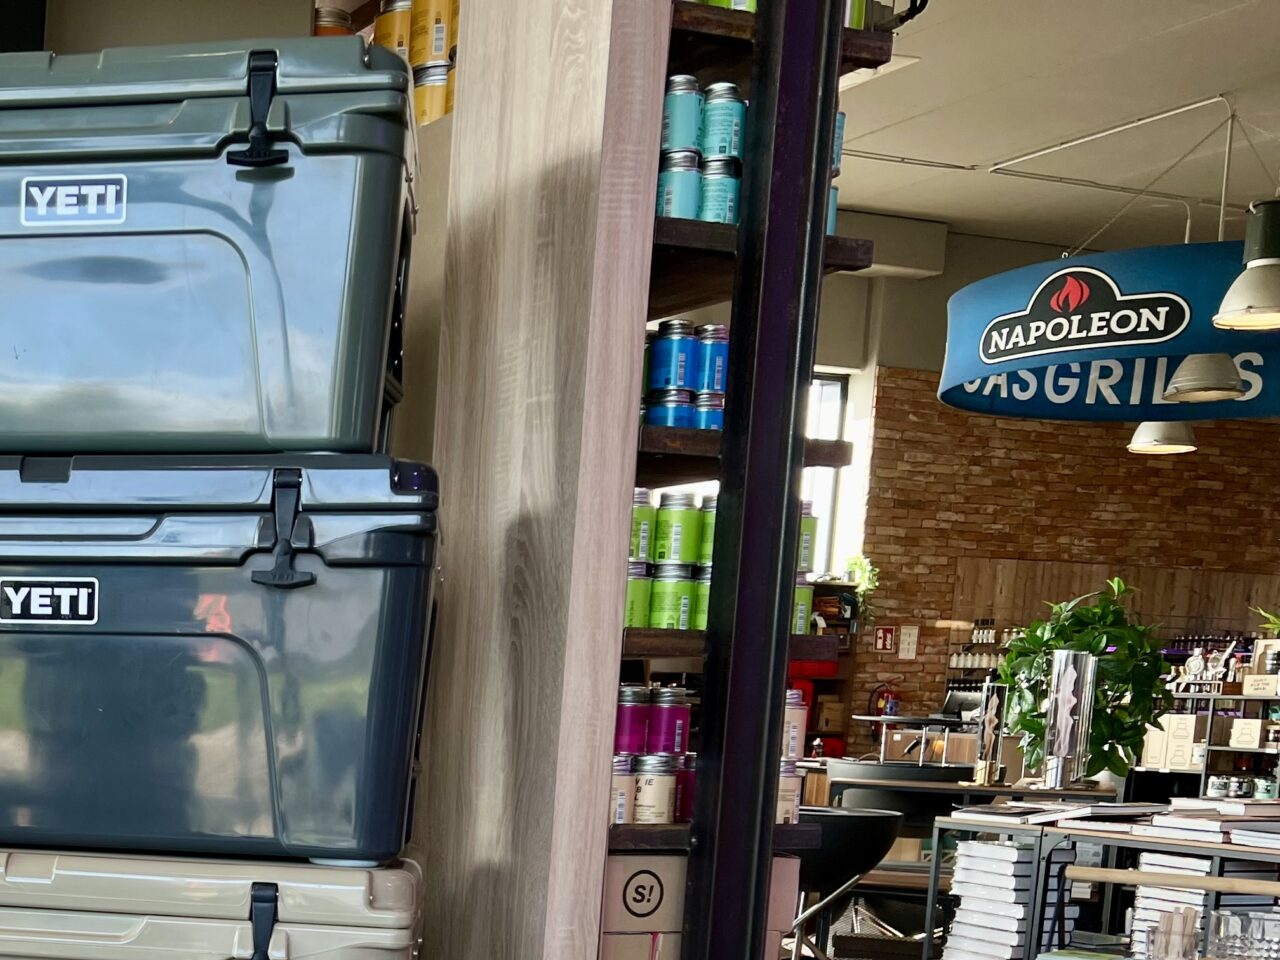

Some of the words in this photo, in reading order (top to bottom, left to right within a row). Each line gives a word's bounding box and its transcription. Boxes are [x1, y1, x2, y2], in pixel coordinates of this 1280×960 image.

[28, 184, 119, 216] YETI
[988, 306, 1170, 354] NAPOLEON
[963, 352, 1264, 405] ASGRILS
[3, 586, 91, 616] YETI
